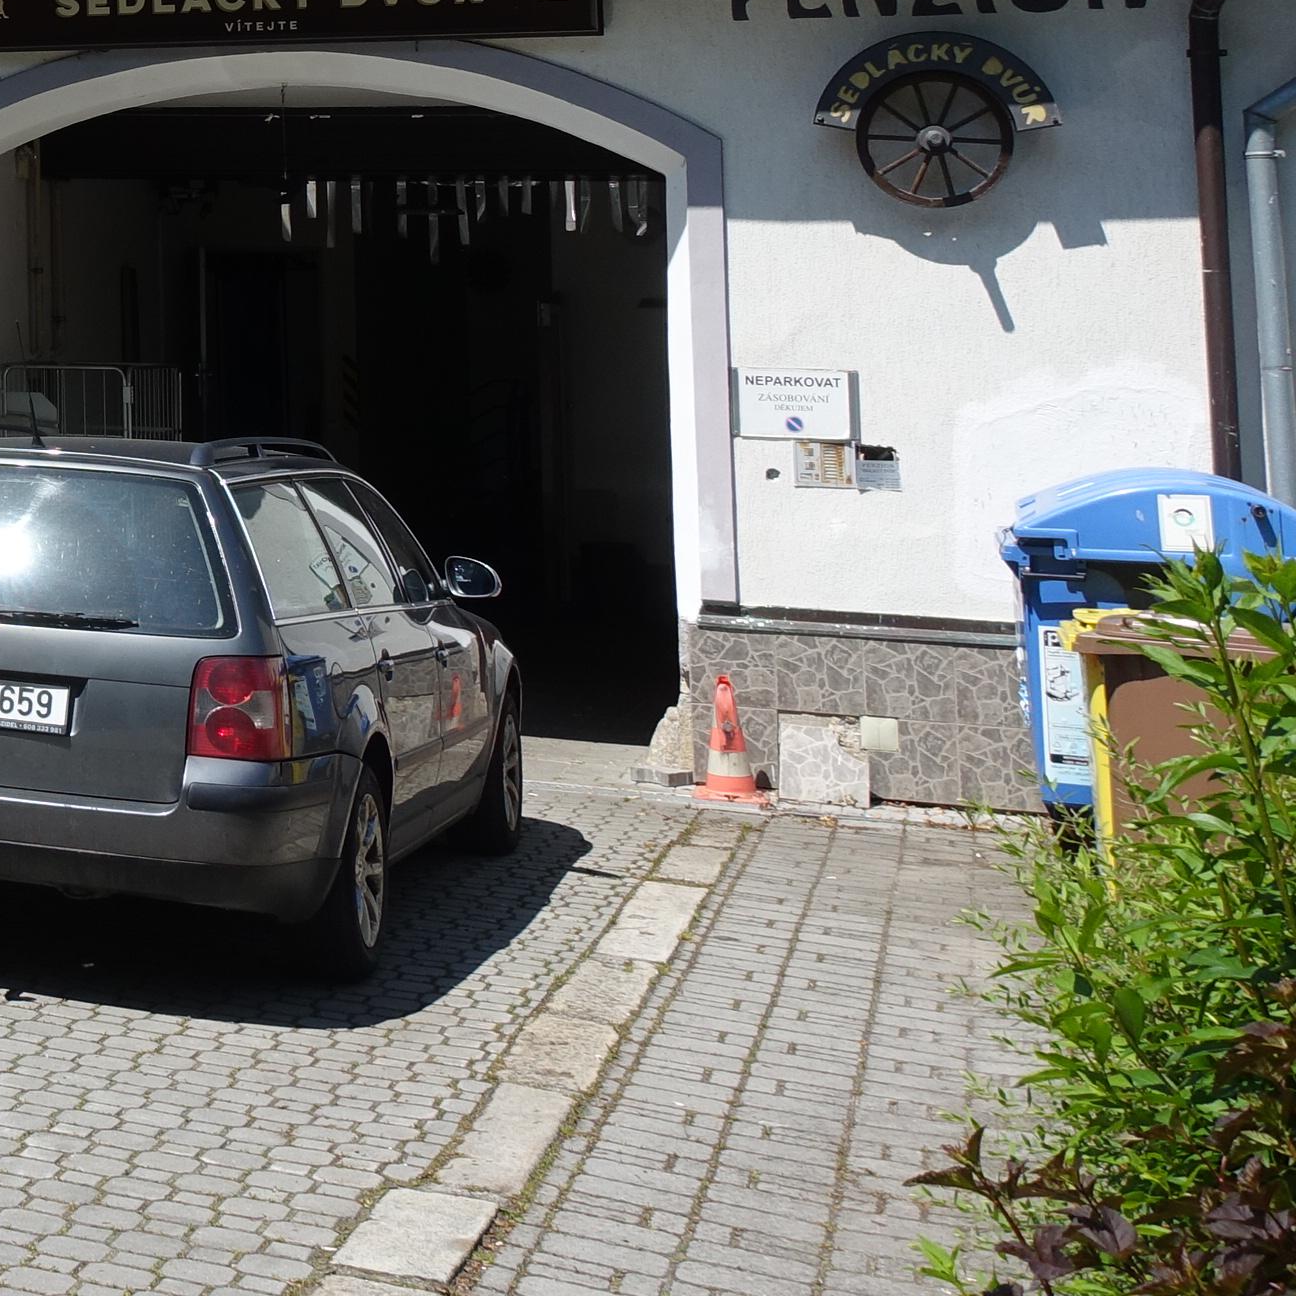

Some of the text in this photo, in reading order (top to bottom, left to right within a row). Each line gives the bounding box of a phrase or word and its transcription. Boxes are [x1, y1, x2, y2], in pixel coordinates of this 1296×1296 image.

[224, 19, 299, 33] VÍTEJTE
[745, 375, 841, 388] NEPARKOVAT
[758, 393, 830, 403] ZÁSOBOVÁNÍ
